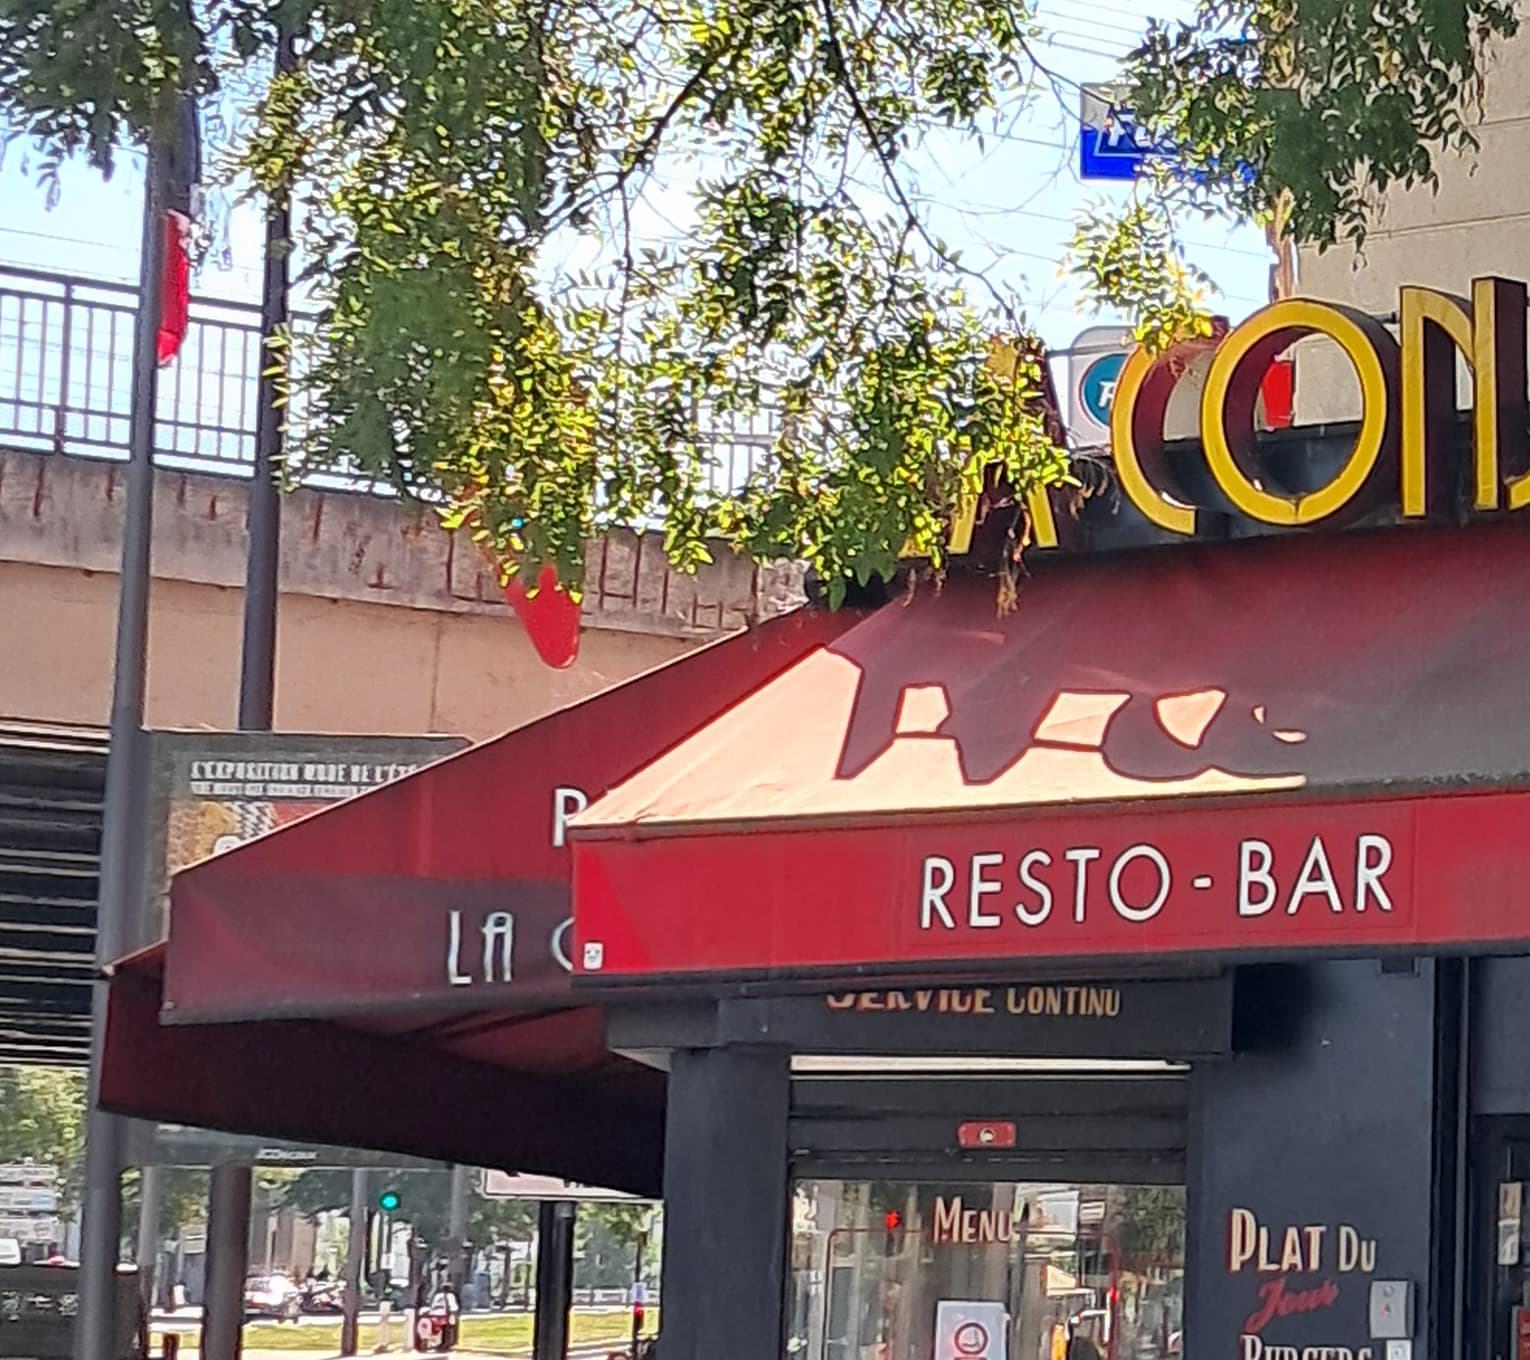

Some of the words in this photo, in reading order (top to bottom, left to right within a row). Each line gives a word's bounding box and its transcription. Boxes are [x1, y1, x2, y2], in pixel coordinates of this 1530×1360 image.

[448, 909, 514, 985] LA
[1006, 986, 1120, 1017] CONTINU
[1226, 1208, 1326, 1274] PLAT
